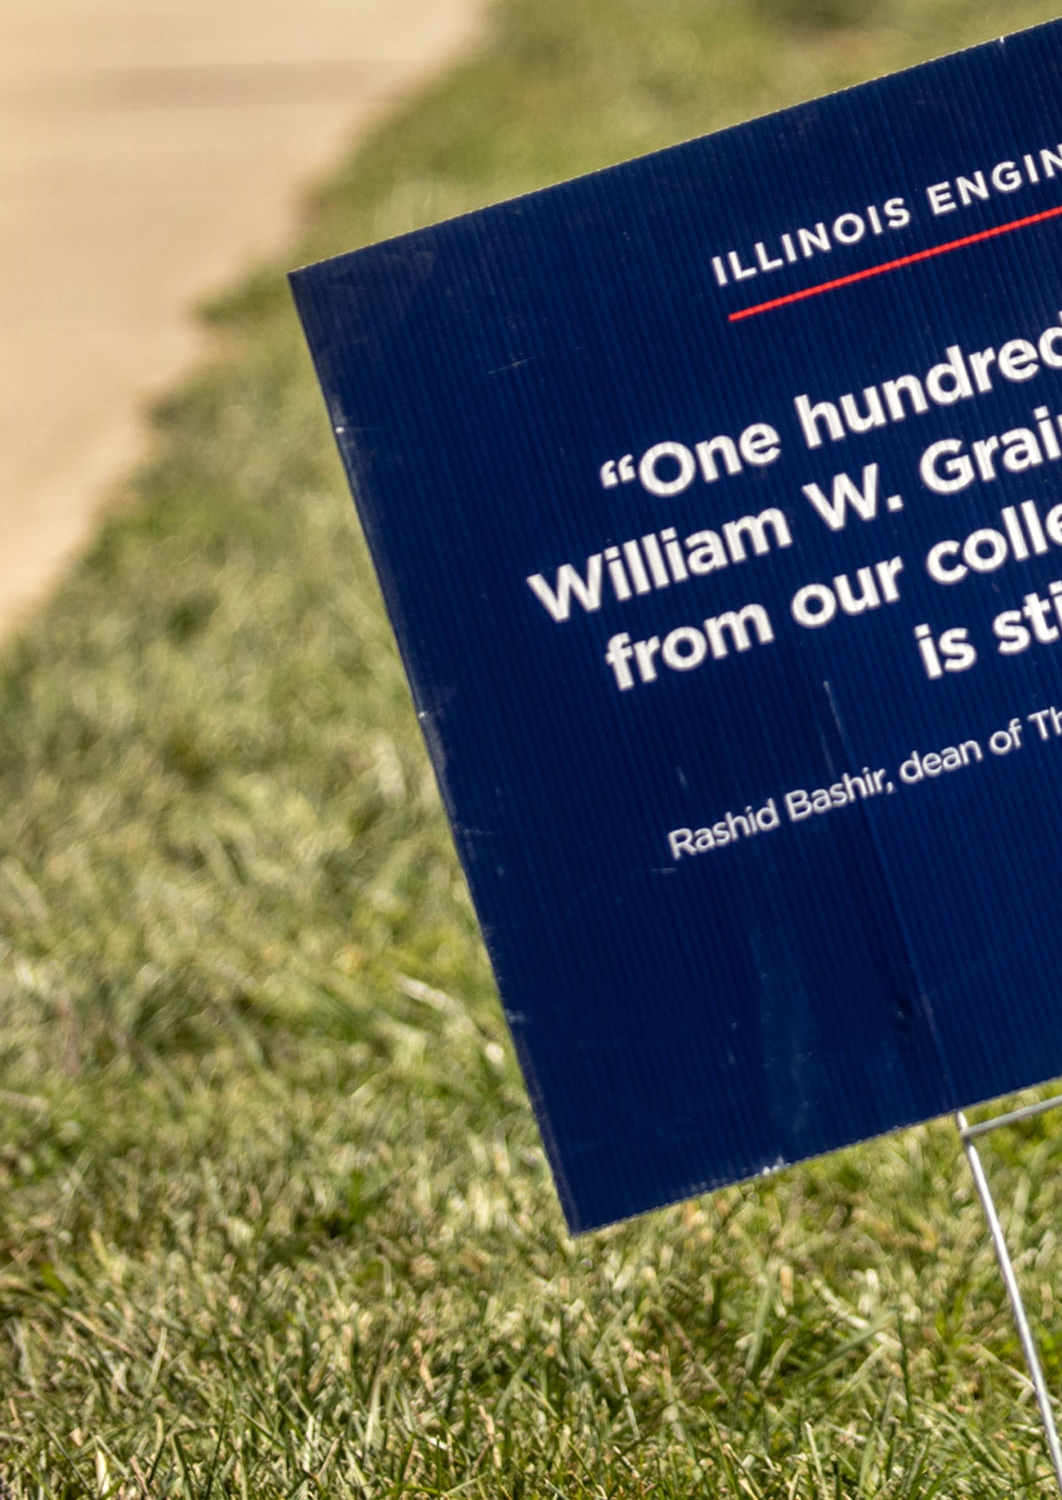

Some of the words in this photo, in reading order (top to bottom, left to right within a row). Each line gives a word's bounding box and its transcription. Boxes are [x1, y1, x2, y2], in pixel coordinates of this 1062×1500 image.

[711, 197, 911, 286] ILLINOIS
[600, 422, 781, 497] “One
[526, 507, 793, 622] William
[801, 462, 904, 531] W.
[605, 603, 775, 691] from
[791, 555, 904, 628] our
[914, 623, 977, 680] is
[667, 797, 780, 860] Rashid
[784, 766, 894, 822] Bashir,
[899, 739, 983, 784] dean
[989, 717, 1022, 755] of
